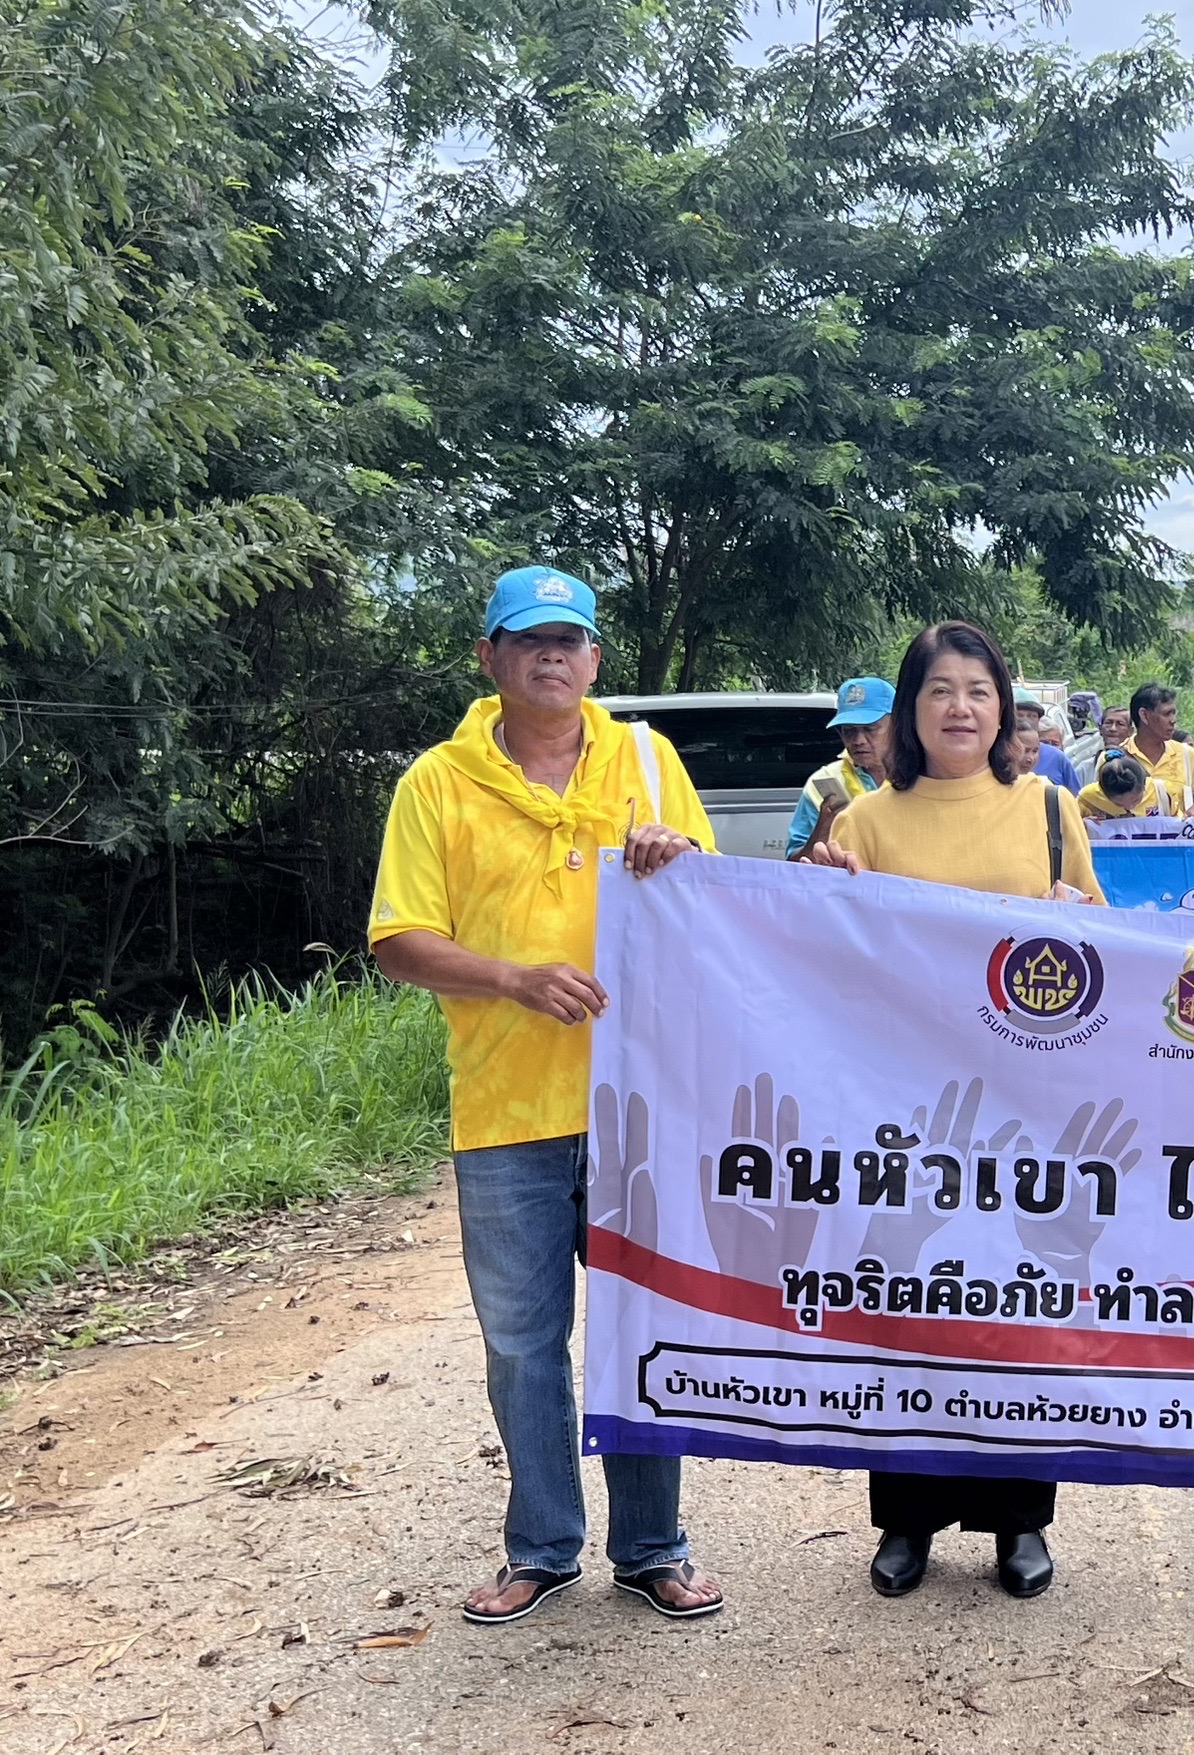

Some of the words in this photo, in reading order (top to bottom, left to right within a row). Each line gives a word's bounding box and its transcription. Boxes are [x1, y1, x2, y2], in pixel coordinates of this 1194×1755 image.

[977, 1005, 1109, 1051] กรมการพัฒนาชุมชน
[718, 1123, 1117, 1217] คนหัวเขา
[782, 1258, 1075, 1327] ทุจริตคือภัย
[665, 1371, 807, 1408] บ้านหัวเขา
[820, 1376, 884, 1420] หมู่ที่
[896, 1388, 933, 1414] 10
[945, 1389, 1147, 1429] ตำบลห้วยยาง
